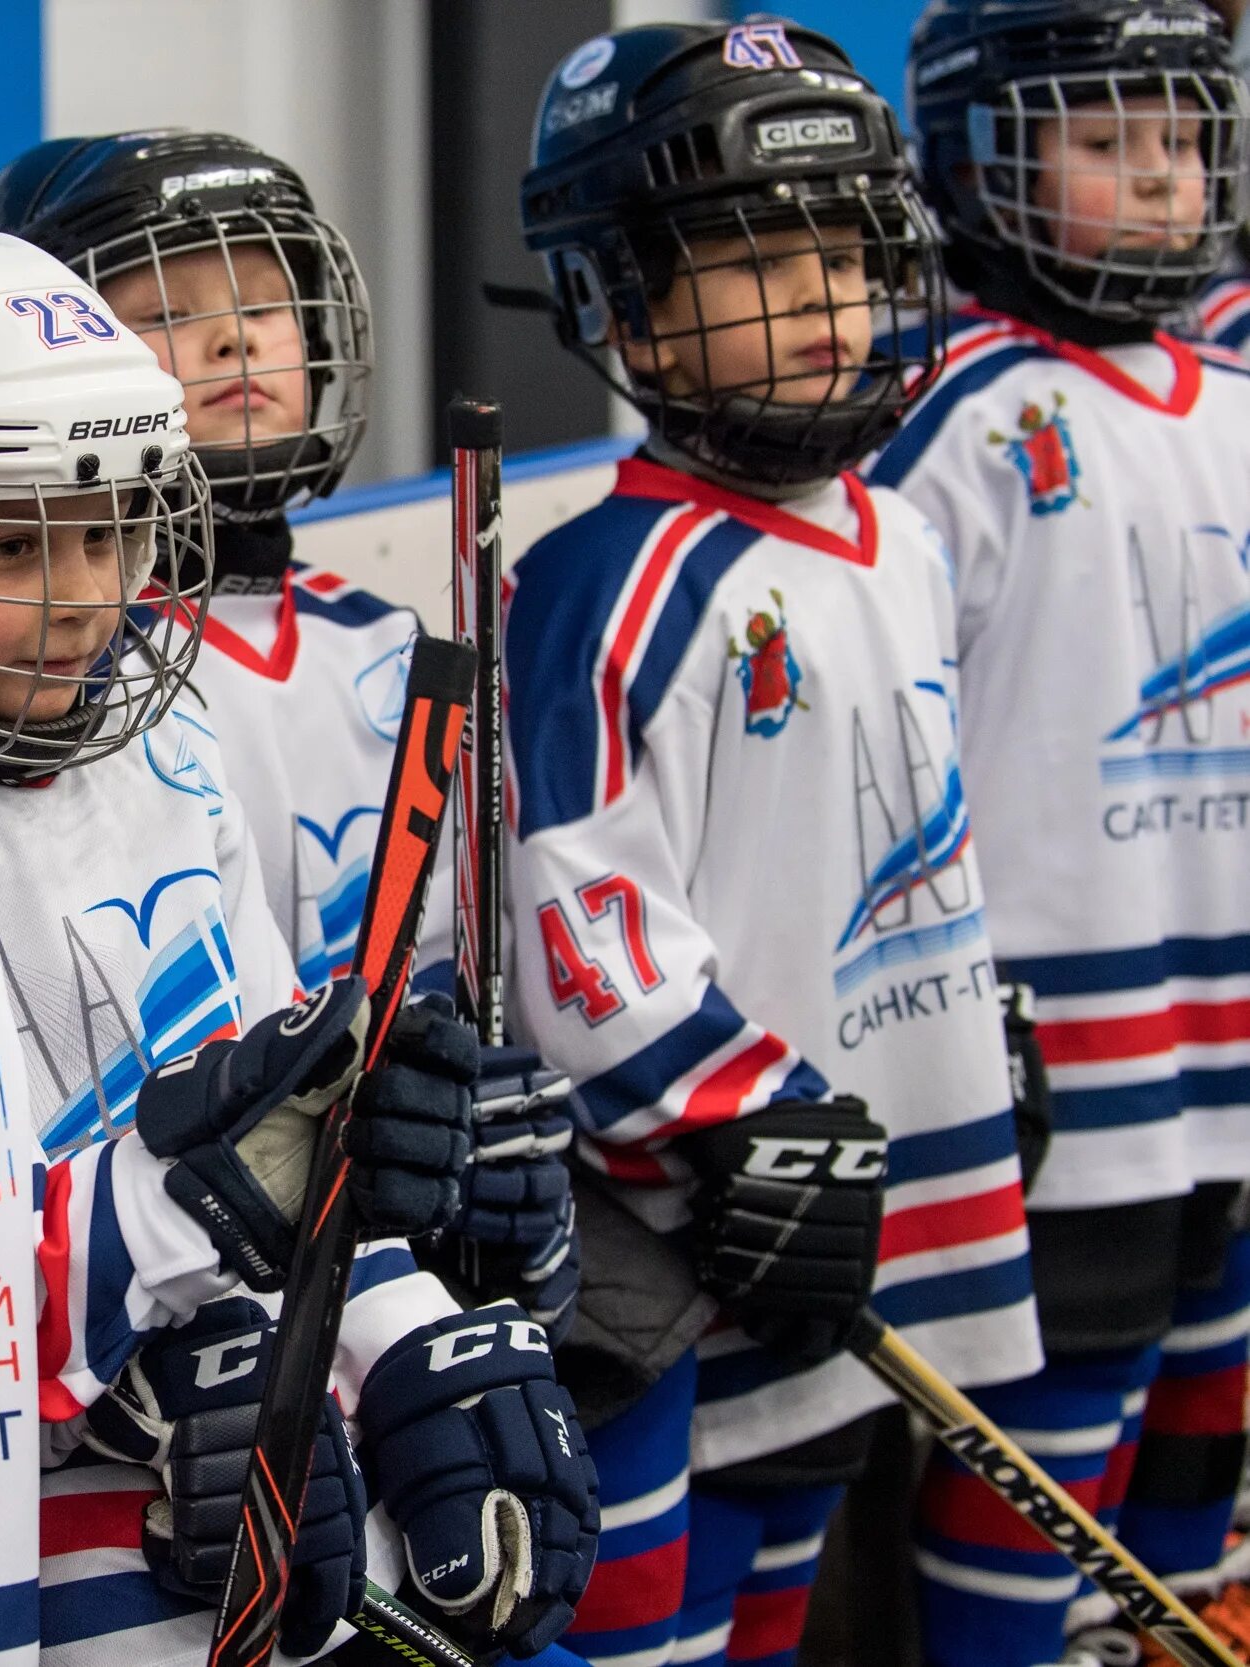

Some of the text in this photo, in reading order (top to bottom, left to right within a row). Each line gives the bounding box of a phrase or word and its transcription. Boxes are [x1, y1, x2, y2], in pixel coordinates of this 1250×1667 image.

[722, 22, 803, 69] 47
[766, 122, 851, 144] CCM
[5, 292, 120, 351] 23
[67, 412, 169, 441] BAUER
[536, 872, 668, 1030] 47
[946, 1424, 1192, 1630] NORDWAY
[421, 1553, 469, 1586] CCM
